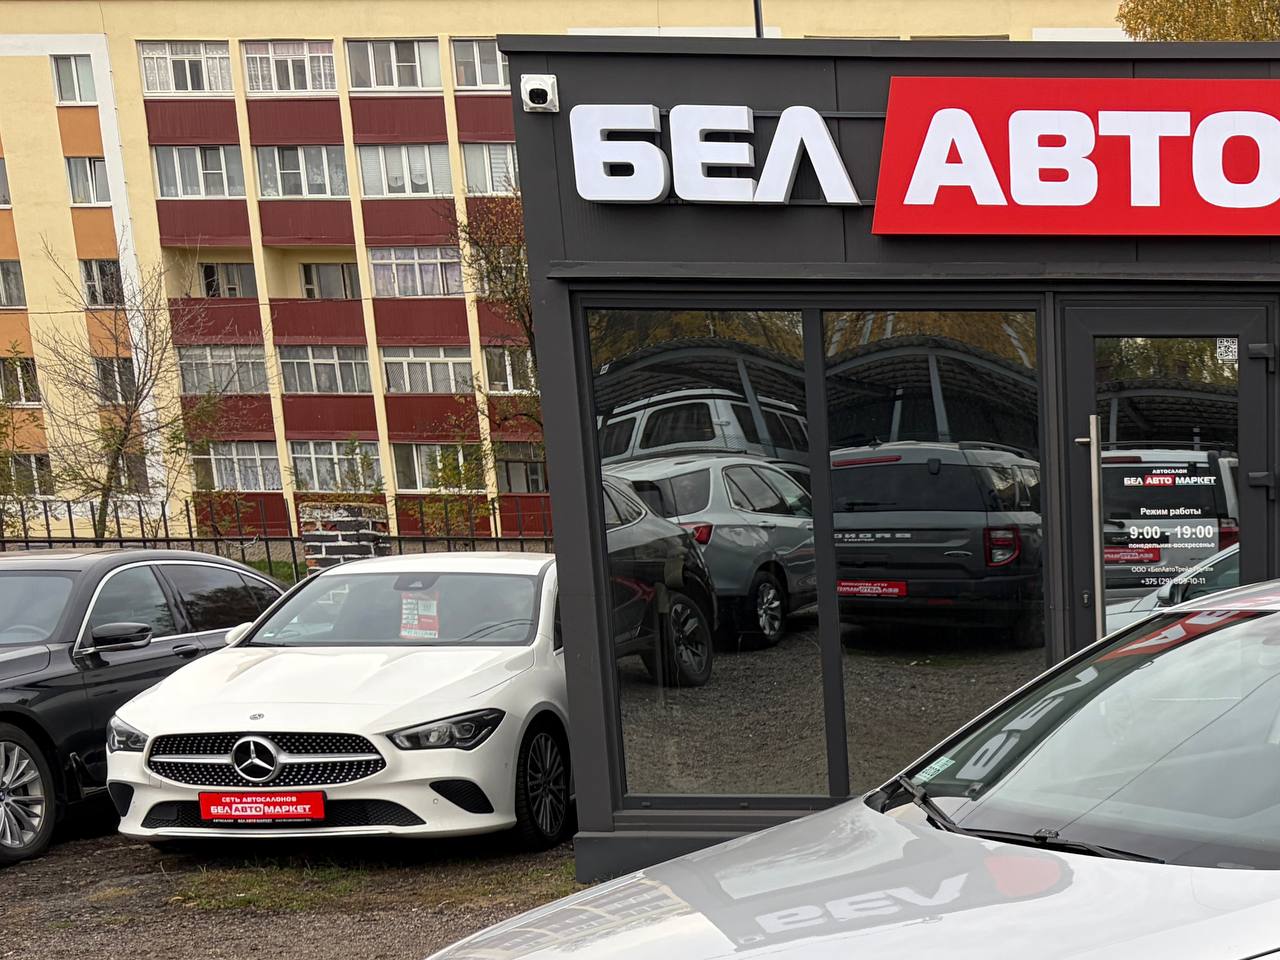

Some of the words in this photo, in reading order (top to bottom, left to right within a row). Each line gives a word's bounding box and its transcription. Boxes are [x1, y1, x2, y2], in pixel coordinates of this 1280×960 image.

[570, 104, 862, 205] БЕЛ
[1124, 477, 1143, 485] БЕЛ
[1175, 476, 1216, 484] МАРКЕТ
[1140, 507, 1168, 516] Режим
[1169, 507, 1202, 517] работы
[1129, 526, 1160, 539] 9:00
[1174, 525, 1213, 539] 19:00
[1141, 577, 1157, 585] +375
[210, 805, 231, 814] БЕЛ
[233, 805, 262, 813] АВТО
[264, 804, 312, 813] МАРКЕТ
